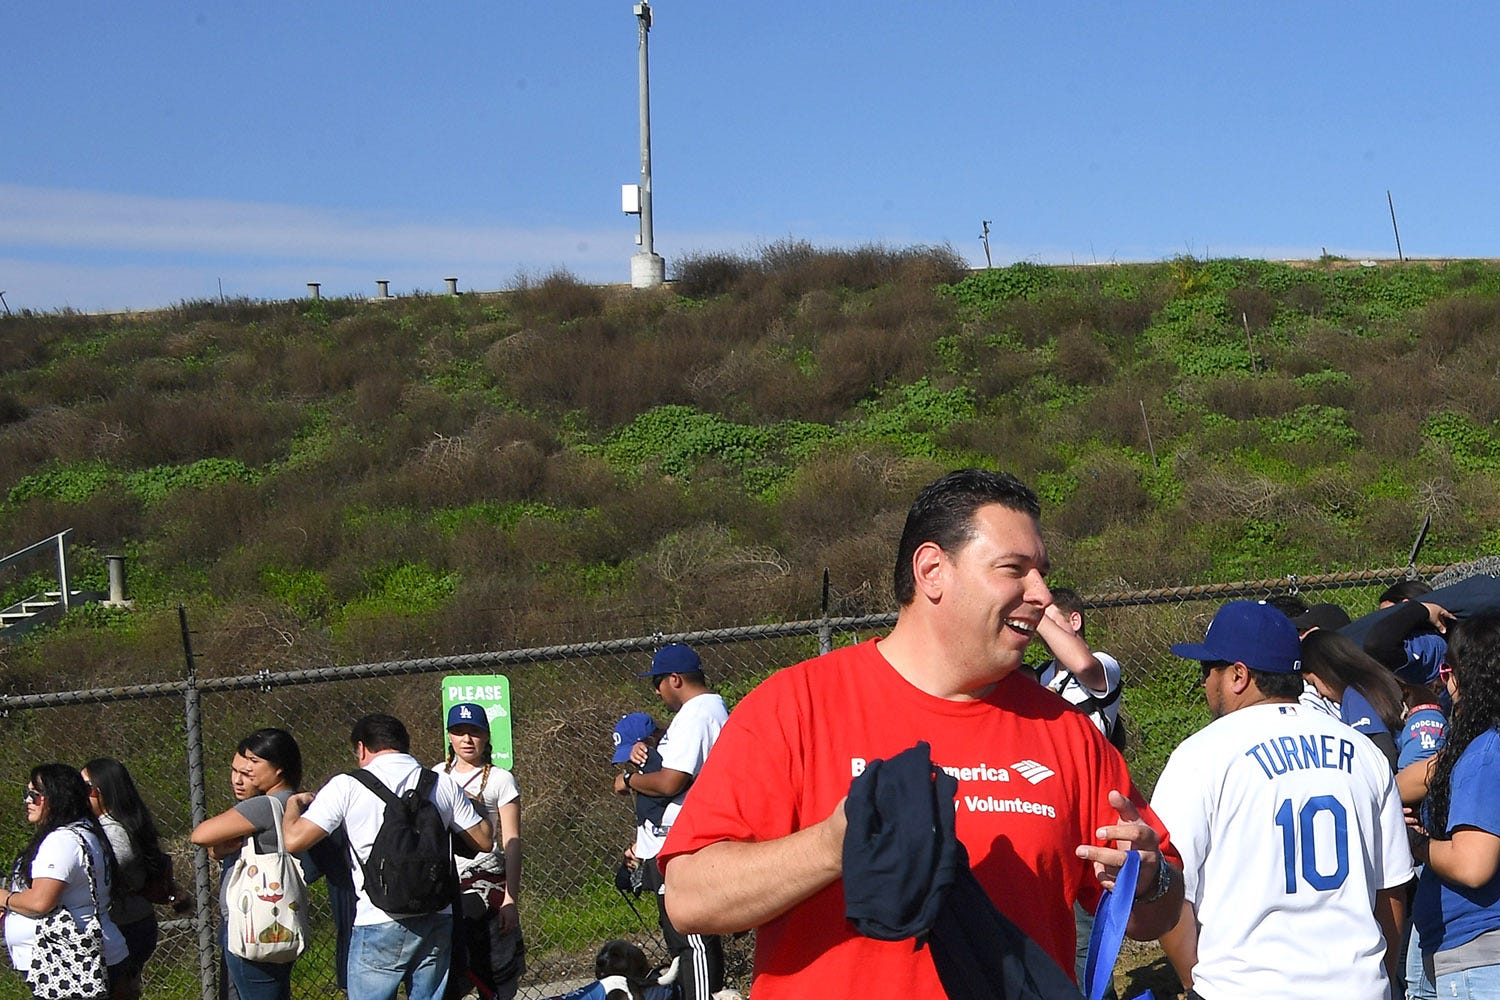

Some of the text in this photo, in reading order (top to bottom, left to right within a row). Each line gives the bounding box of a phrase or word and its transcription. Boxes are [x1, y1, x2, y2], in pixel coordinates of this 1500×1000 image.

[448, 685, 503, 701] PLEASE
[459, 705, 472, 719] LA
[1419, 731, 1435, 749] LA
[1245, 735, 1355, 780] TURNER
[942, 763, 1010, 783] merica
[964, 796, 1056, 818] Volunteers
[1275, 795, 1350, 894] 10
